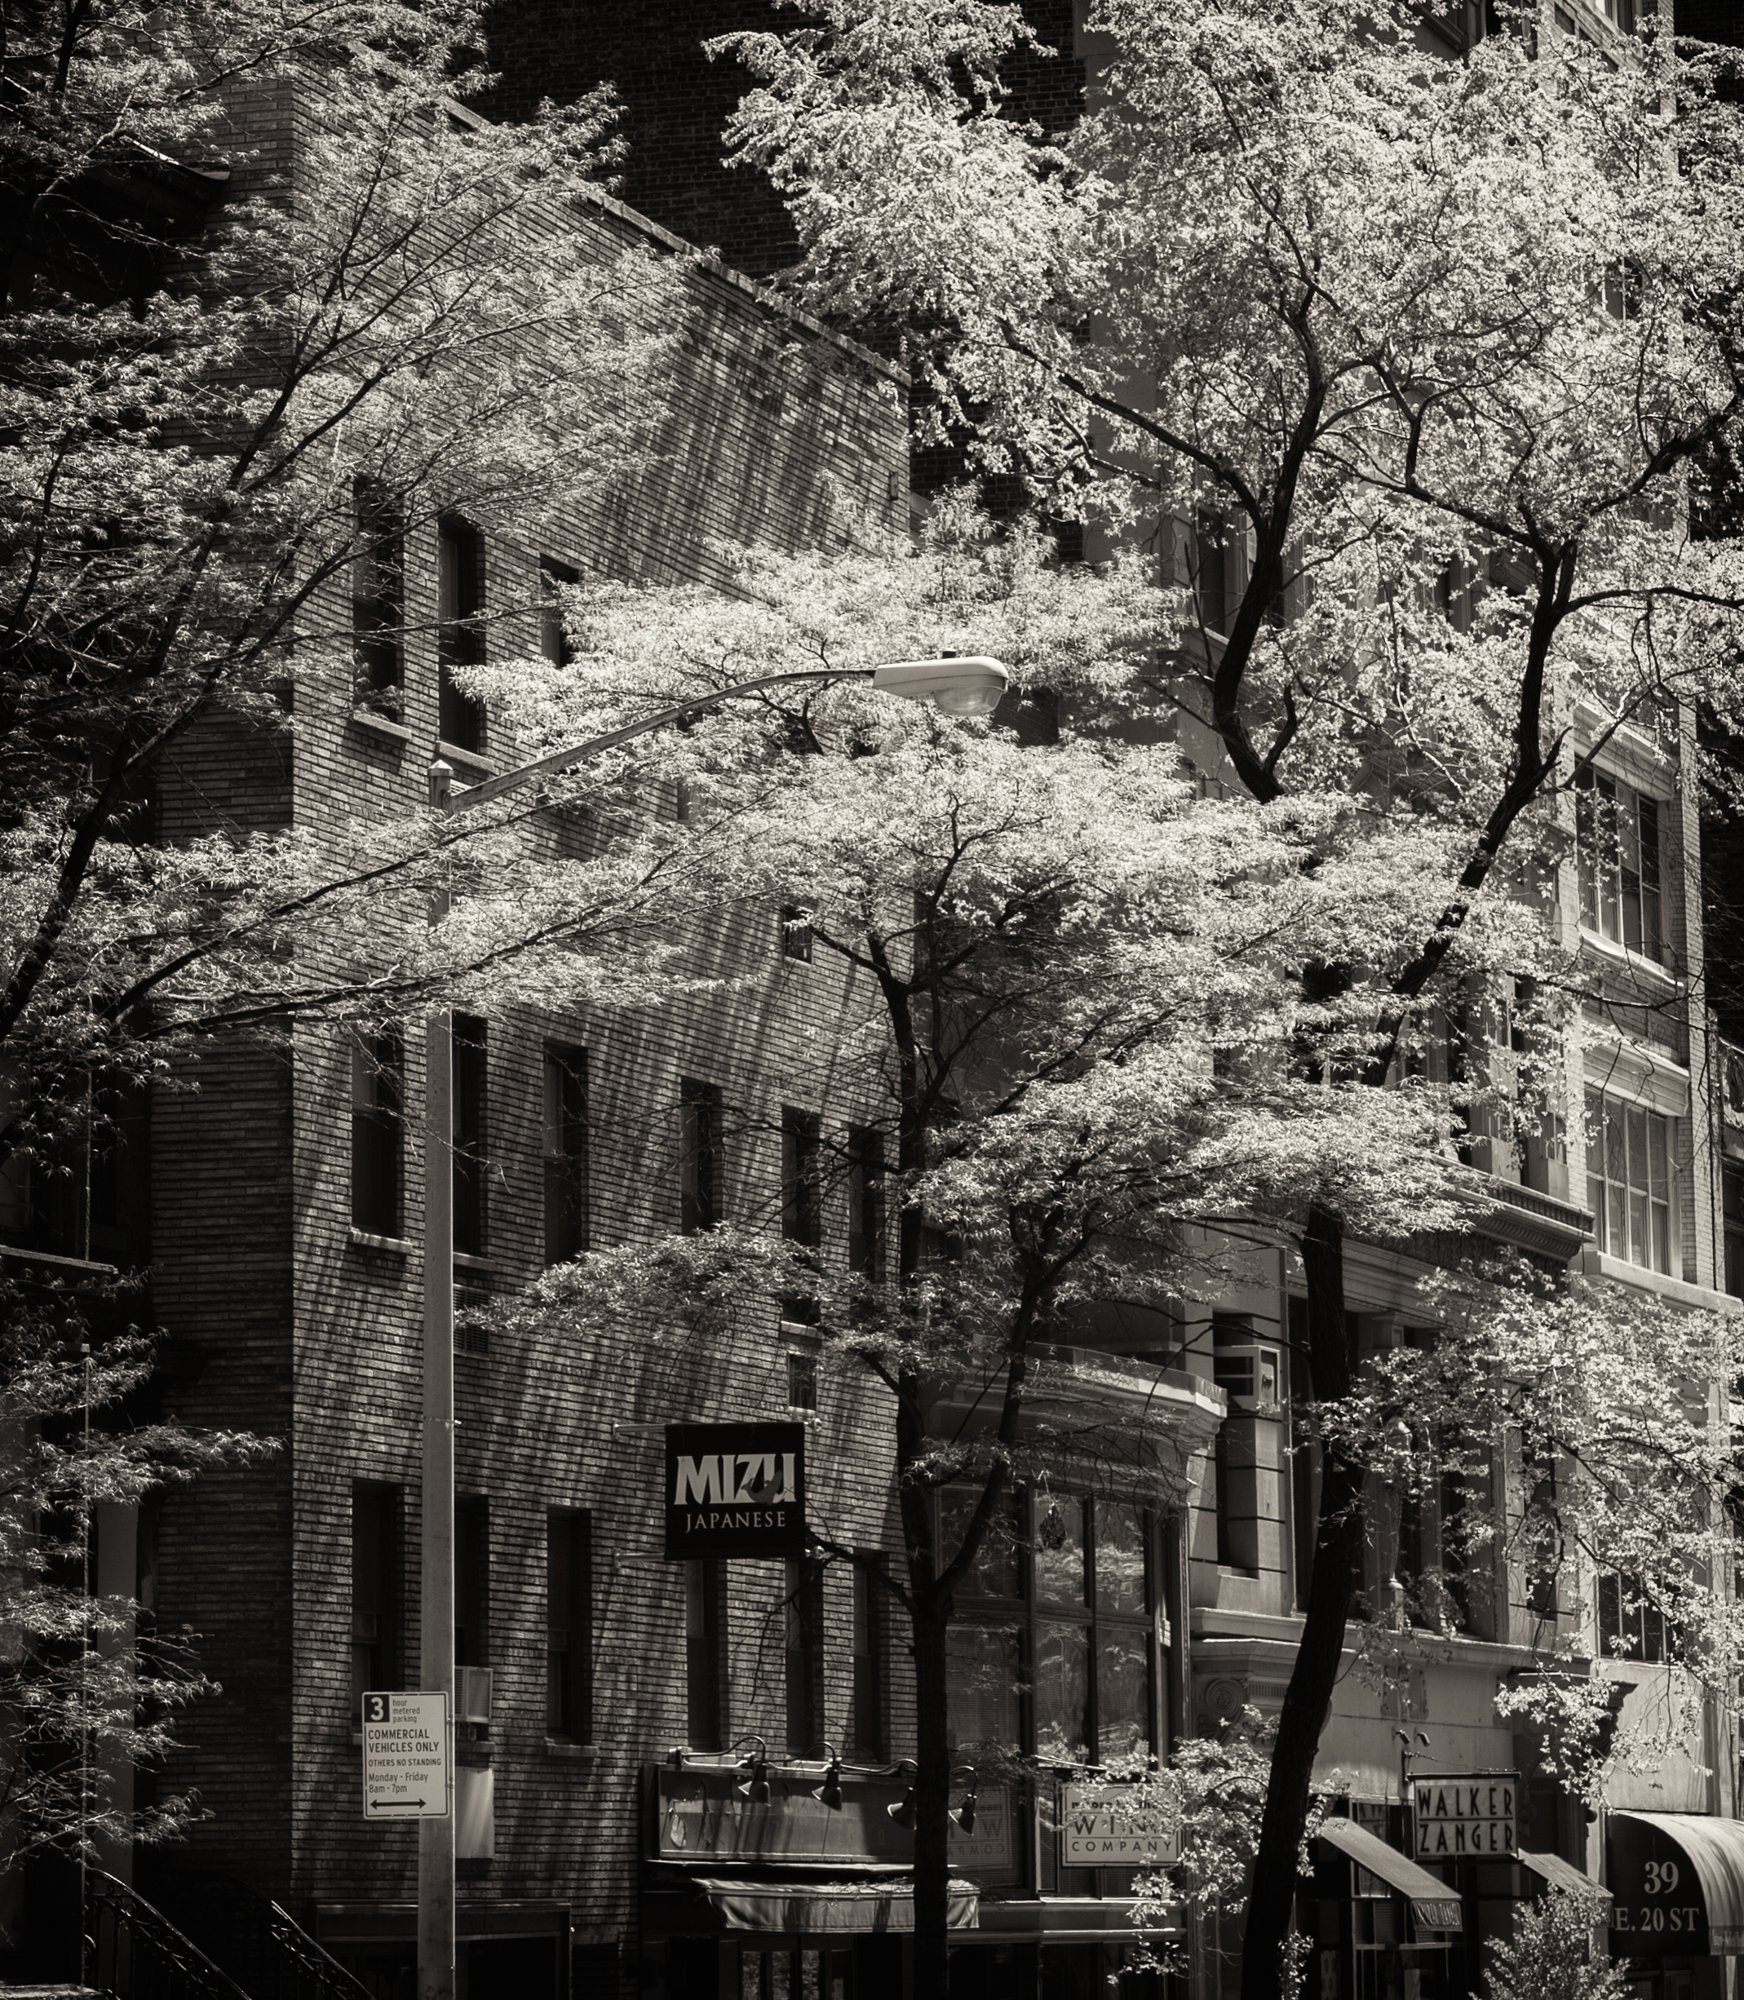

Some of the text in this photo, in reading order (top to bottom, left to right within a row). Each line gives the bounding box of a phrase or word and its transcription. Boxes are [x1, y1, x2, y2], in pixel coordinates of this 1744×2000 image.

[673, 1453, 797, 1505] MIZU
[685, 1511, 787, 1534] JAPANESE
[370, 1696, 384, 1721] 3
[392, 1699, 408, 1707] hour
[392, 1715, 418, 1724] parking
[368, 1729, 430, 1740] COMMERCIAL
[368, 1741, 440, 1753] VEHICLES ONLY
[368, 1758, 442, 1767] OTHERS NO STANDING
[368, 1772, 399, 1783] Monday
[405, 1772, 429, 1782] Friday
[368, 1784, 386, 1793] 8am
[391, 1784, 408, 1794] 7pm
[1418, 1787, 1513, 1817] WALKER
[1073, 1815, 1171, 1836] WIN
[1418, 1823, 1513, 1853] ZANGER
[1072, 1841, 1172, 1852] COMPANY
[1644, 1861, 1679, 1894] 39
[1614, 1907, 1699, 1931] E. 20 ST
